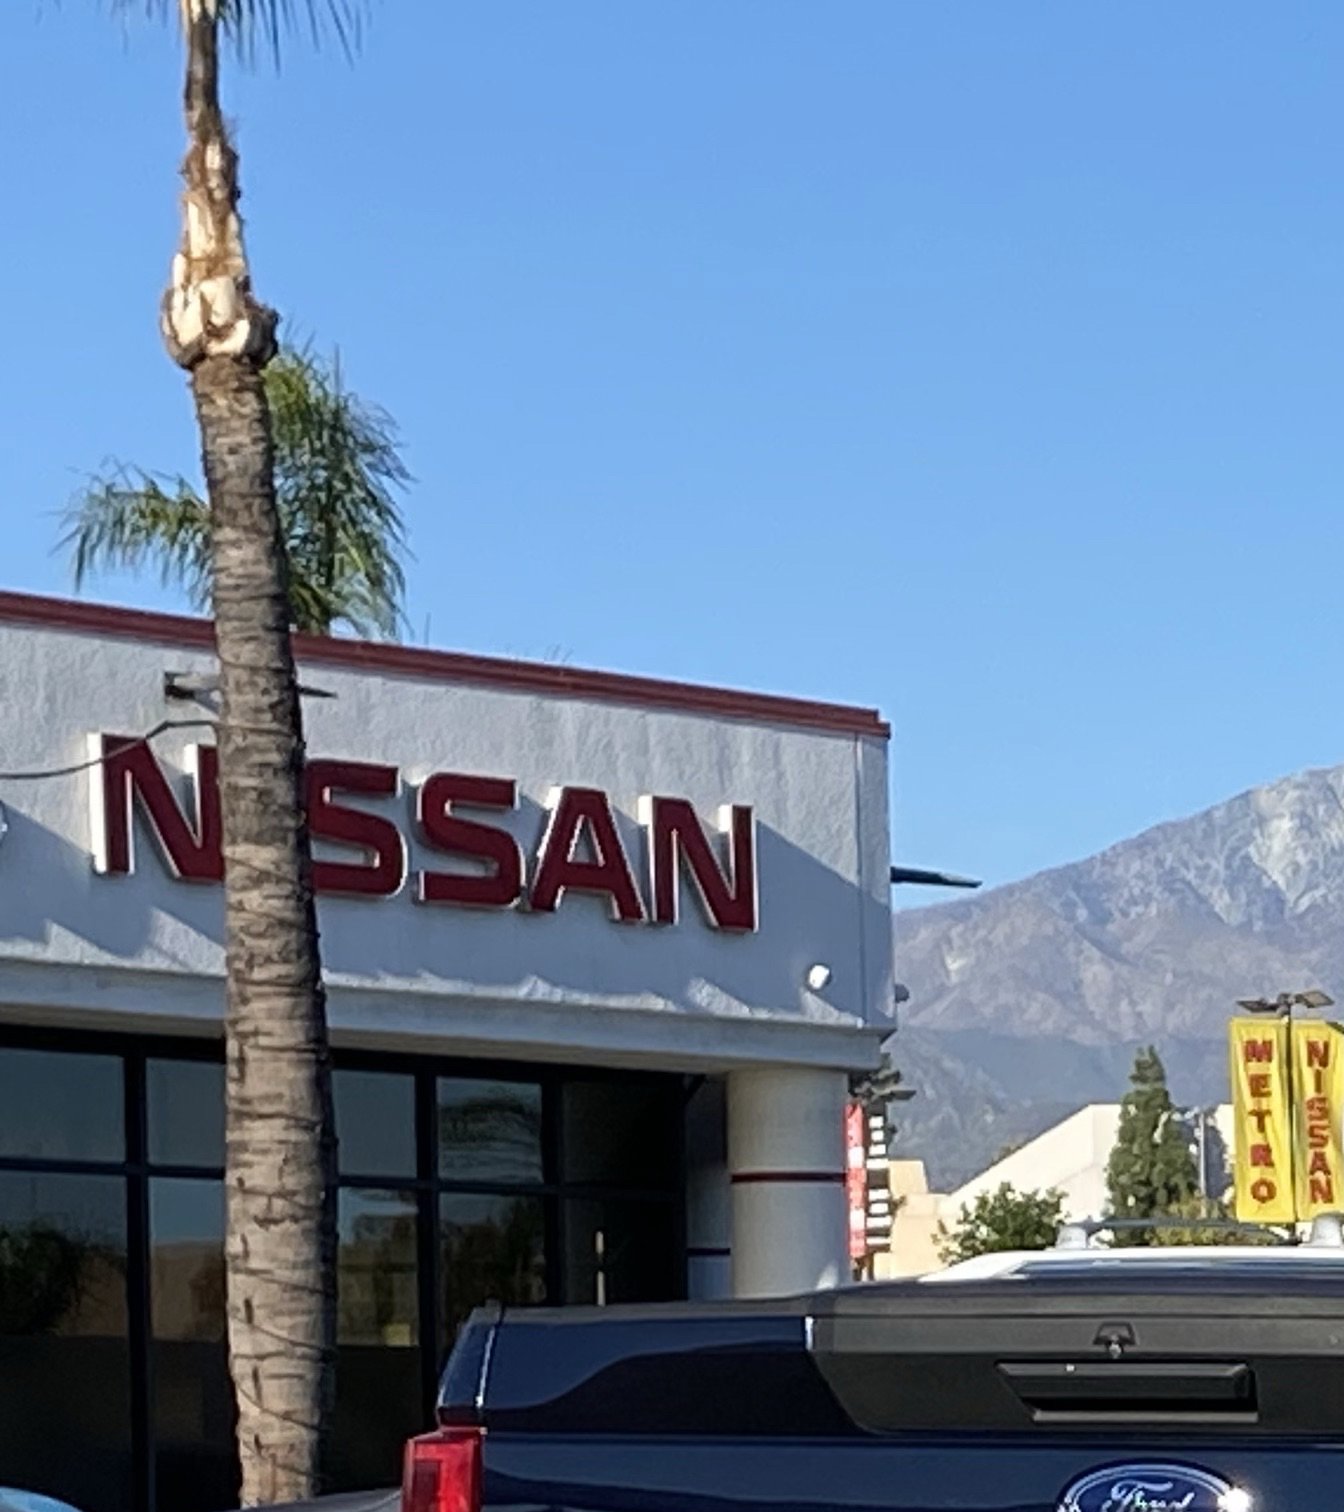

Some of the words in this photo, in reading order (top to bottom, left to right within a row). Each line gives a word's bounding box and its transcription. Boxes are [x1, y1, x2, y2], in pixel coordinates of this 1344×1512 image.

[88, 732, 758, 934] NSSAN
[1244, 1040, 1277, 1204] METRO
[1306, 1040, 1335, 1204] NISSAN
